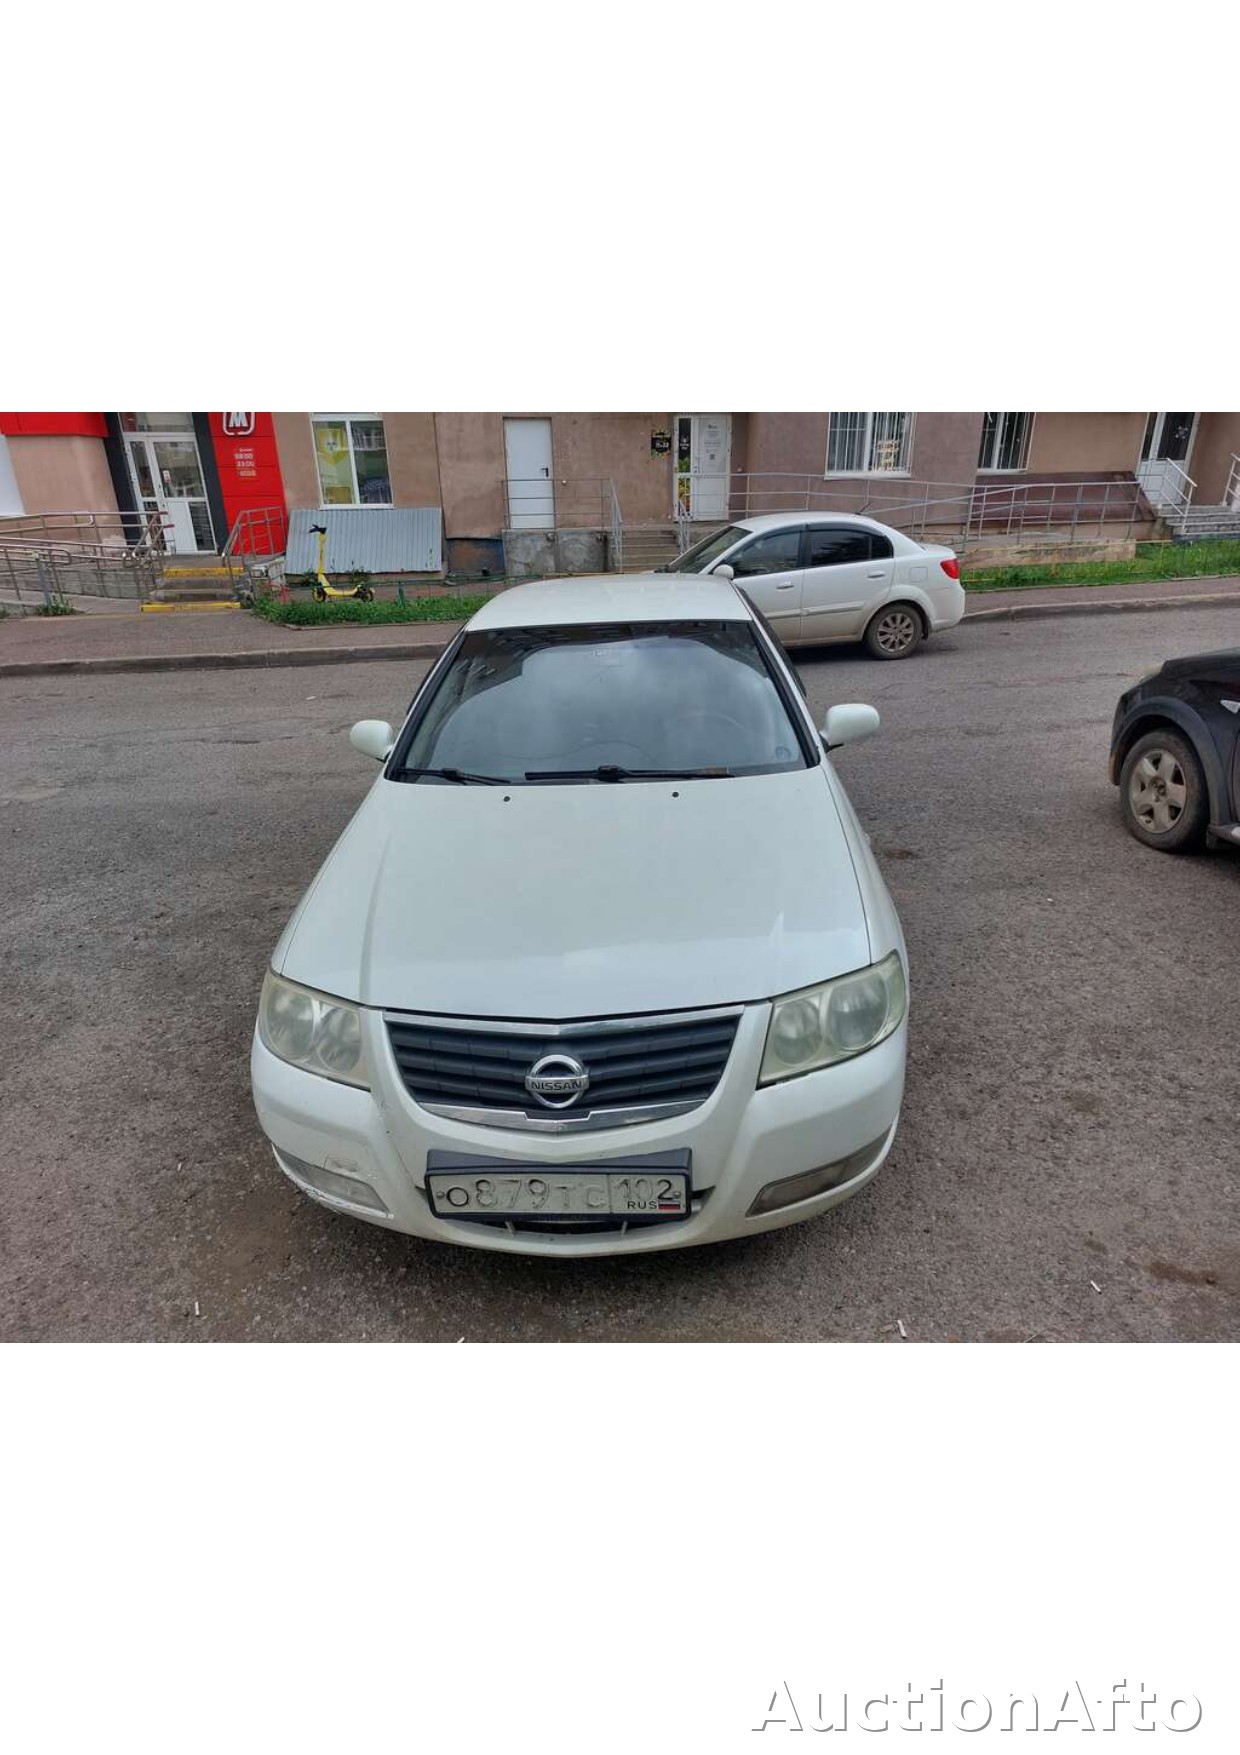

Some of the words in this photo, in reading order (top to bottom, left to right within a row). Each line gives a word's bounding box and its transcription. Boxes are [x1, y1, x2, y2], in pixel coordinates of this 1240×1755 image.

[531, 1081, 582, 1091] NISSAN
[612, 1177, 673, 1201] 102
[627, 1200, 657, 1210] RUS
